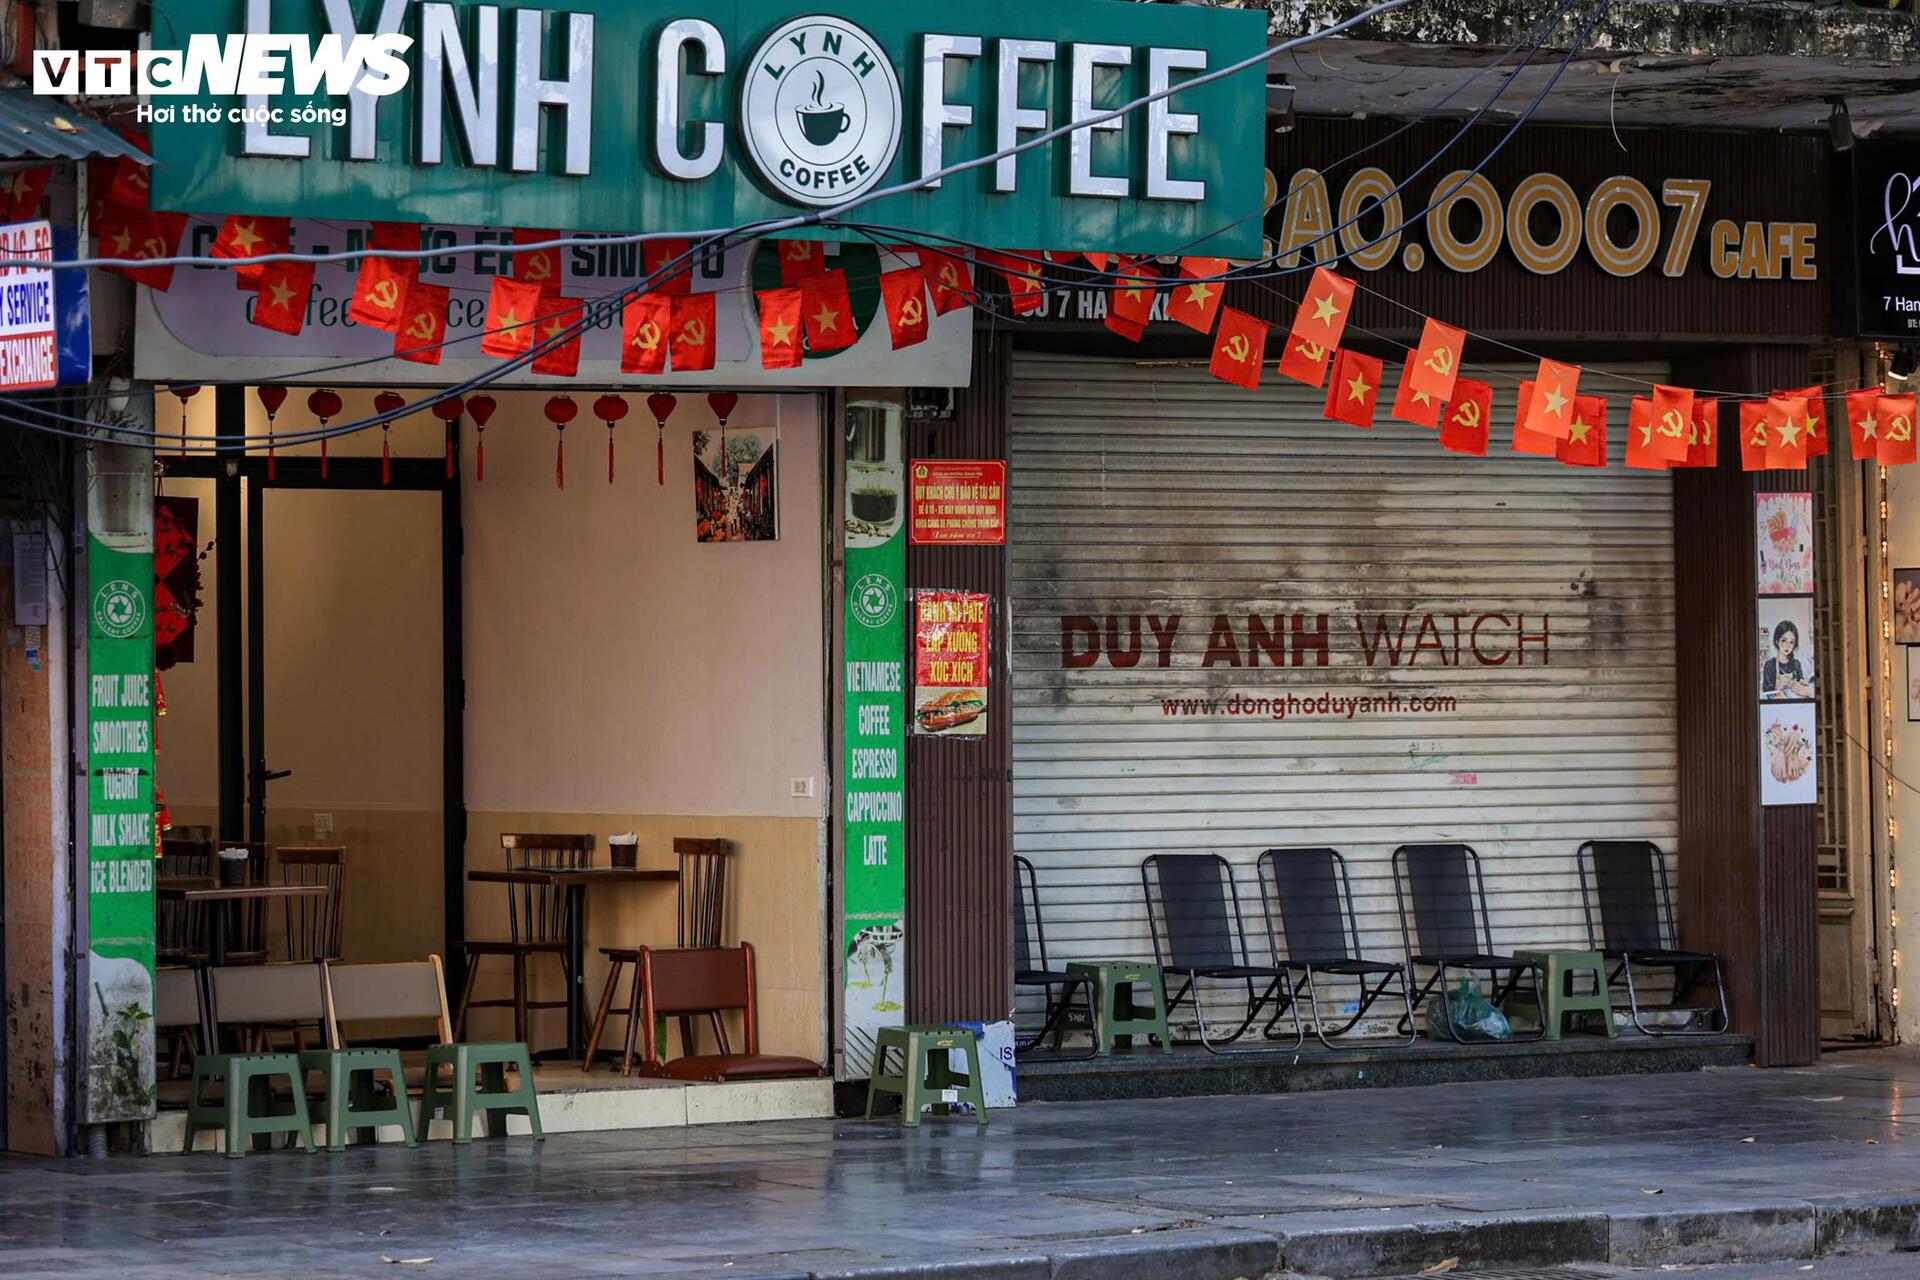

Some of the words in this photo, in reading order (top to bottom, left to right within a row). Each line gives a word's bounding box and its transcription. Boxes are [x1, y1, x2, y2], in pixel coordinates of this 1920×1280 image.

[764, 31, 876, 80] LYNH
[245, 0, 595, 176] LYNH
[779, 155, 870, 189] COFFEE
[571, 233, 648, 278] SIN
[1711, 219, 1817, 280] CAFE
[7, 280, 51, 327] SERVICE
[1057, 290, 1071, 318] 7
[1078, 288, 1107, 319] HÀ
[1883, 296, 1892, 311] 7
[0, 335, 55, 385] EXCHANGE
[1061, 614, 1182, 668] DUY
[1201, 613, 1329, 668] ANH
[1355, 613, 1549, 667] WATCH
[92, 673, 119, 708] FRUIT
[121, 673, 149, 708] JUICE
[846, 661, 901, 692] VIETNAMESE
[858, 704, 890, 736] COFFEE
[1160, 691, 1457, 719] www.donghoduyanh.com
[92, 720, 149, 754] SMOOTHIES
[851, 748, 897, 779] ESPRESSO
[847, 791, 902, 823] CAPPUCCINO
[92, 814, 117, 847] MILK
[118, 812, 151, 847] SHAKE
[863, 834, 888, 866] LATTE
[90, 860, 107, 893] ICE
[109, 859, 153, 893] BLENDED
